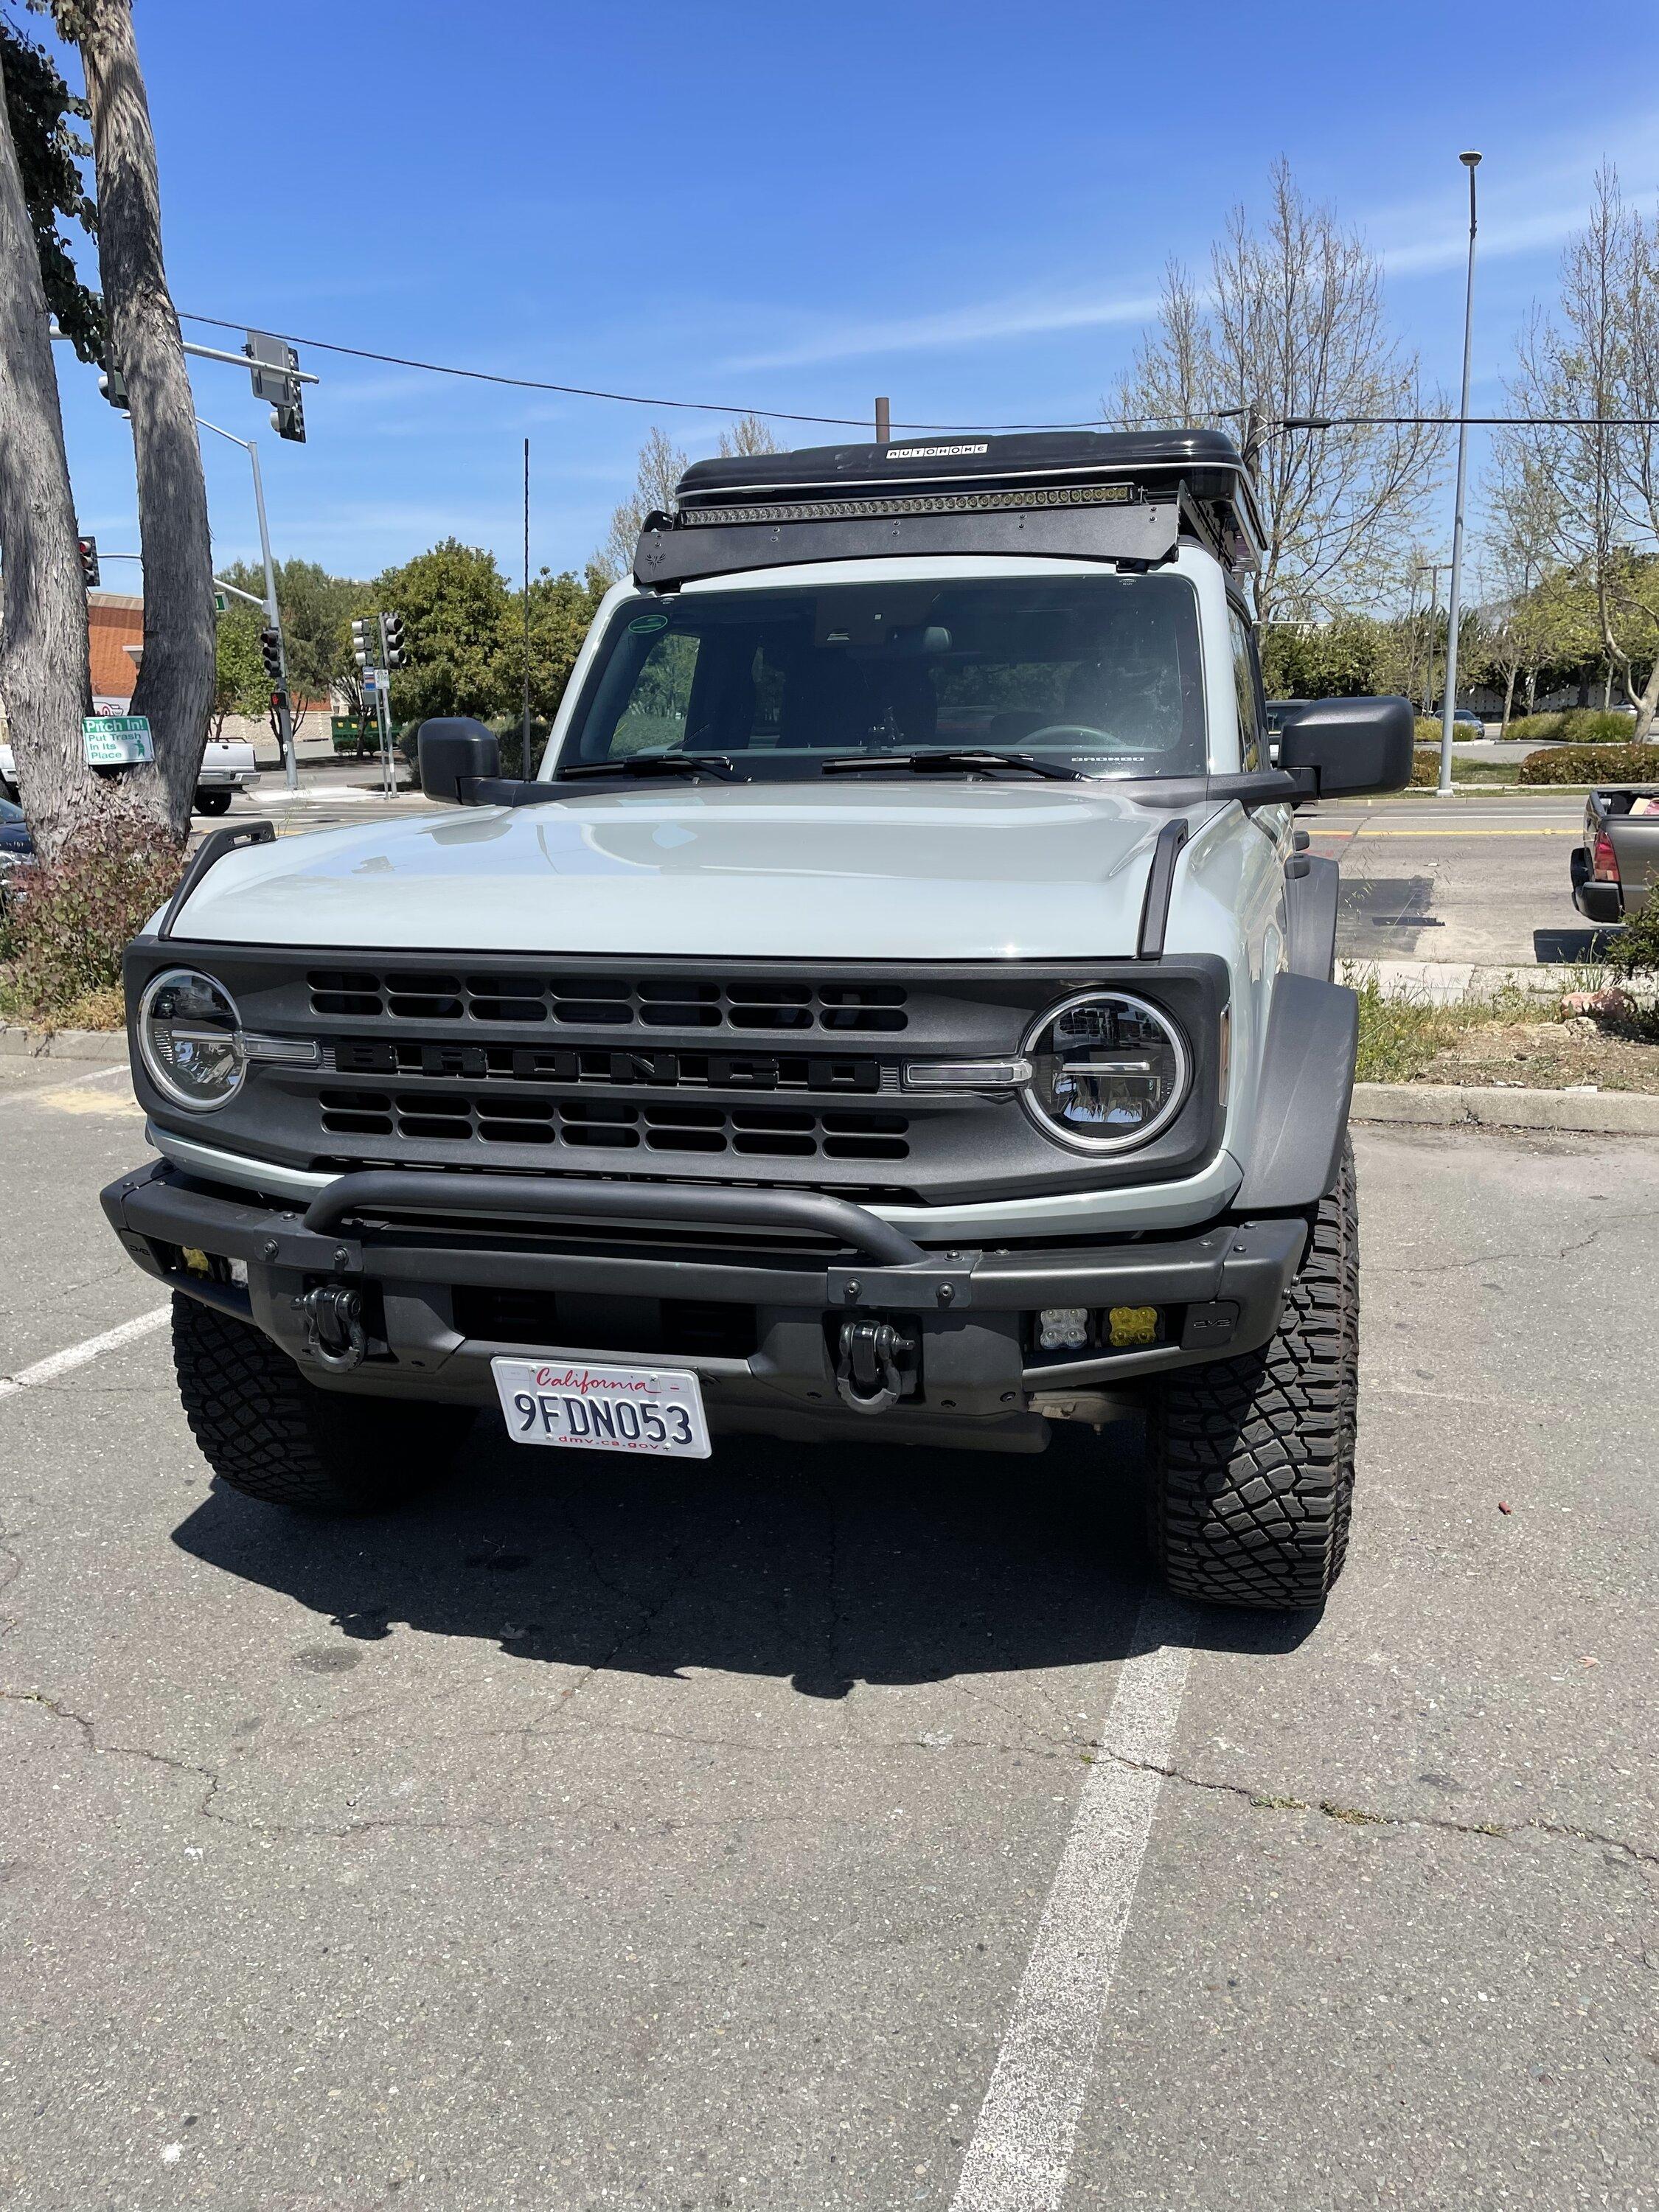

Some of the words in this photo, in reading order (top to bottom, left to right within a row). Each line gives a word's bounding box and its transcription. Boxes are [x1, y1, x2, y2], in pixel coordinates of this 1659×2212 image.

[888, 445, 986, 457] AUTOHOME
[86, 720, 122, 732] Pitch
[126, 718, 144, 731] In!
[110, 732, 142, 741] Trash
[335, 1042, 880, 1093] BRONCO
[535, 1366, 662, 1395] California
[513, 1393, 693, 1445] 9FDN053
[558, 1436, 659, 1450] dmv.ca.gov
